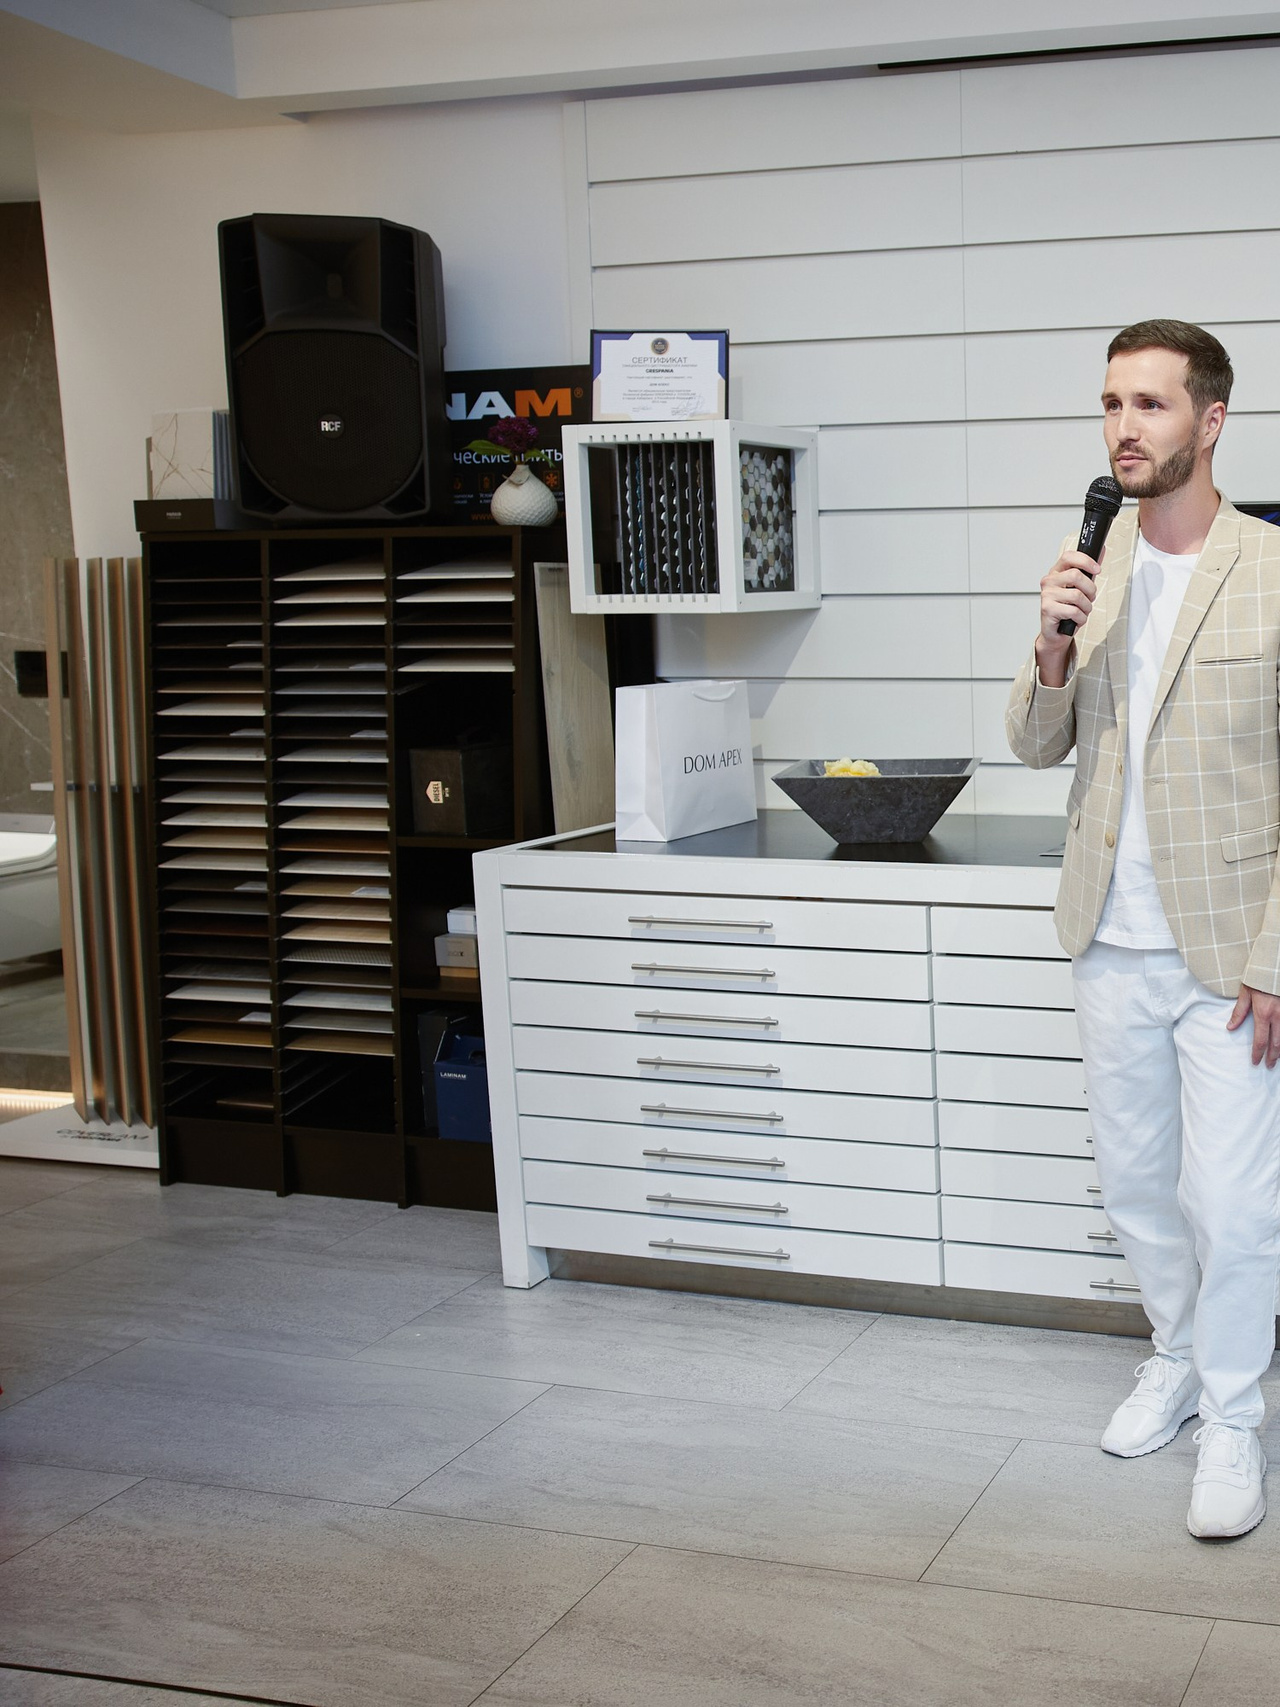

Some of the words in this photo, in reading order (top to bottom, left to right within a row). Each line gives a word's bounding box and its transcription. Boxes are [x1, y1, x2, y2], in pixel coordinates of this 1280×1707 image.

[321, 421, 341, 431] RCF
[684, 753, 716, 774] DOM
[719, 748, 743, 768] APEX
